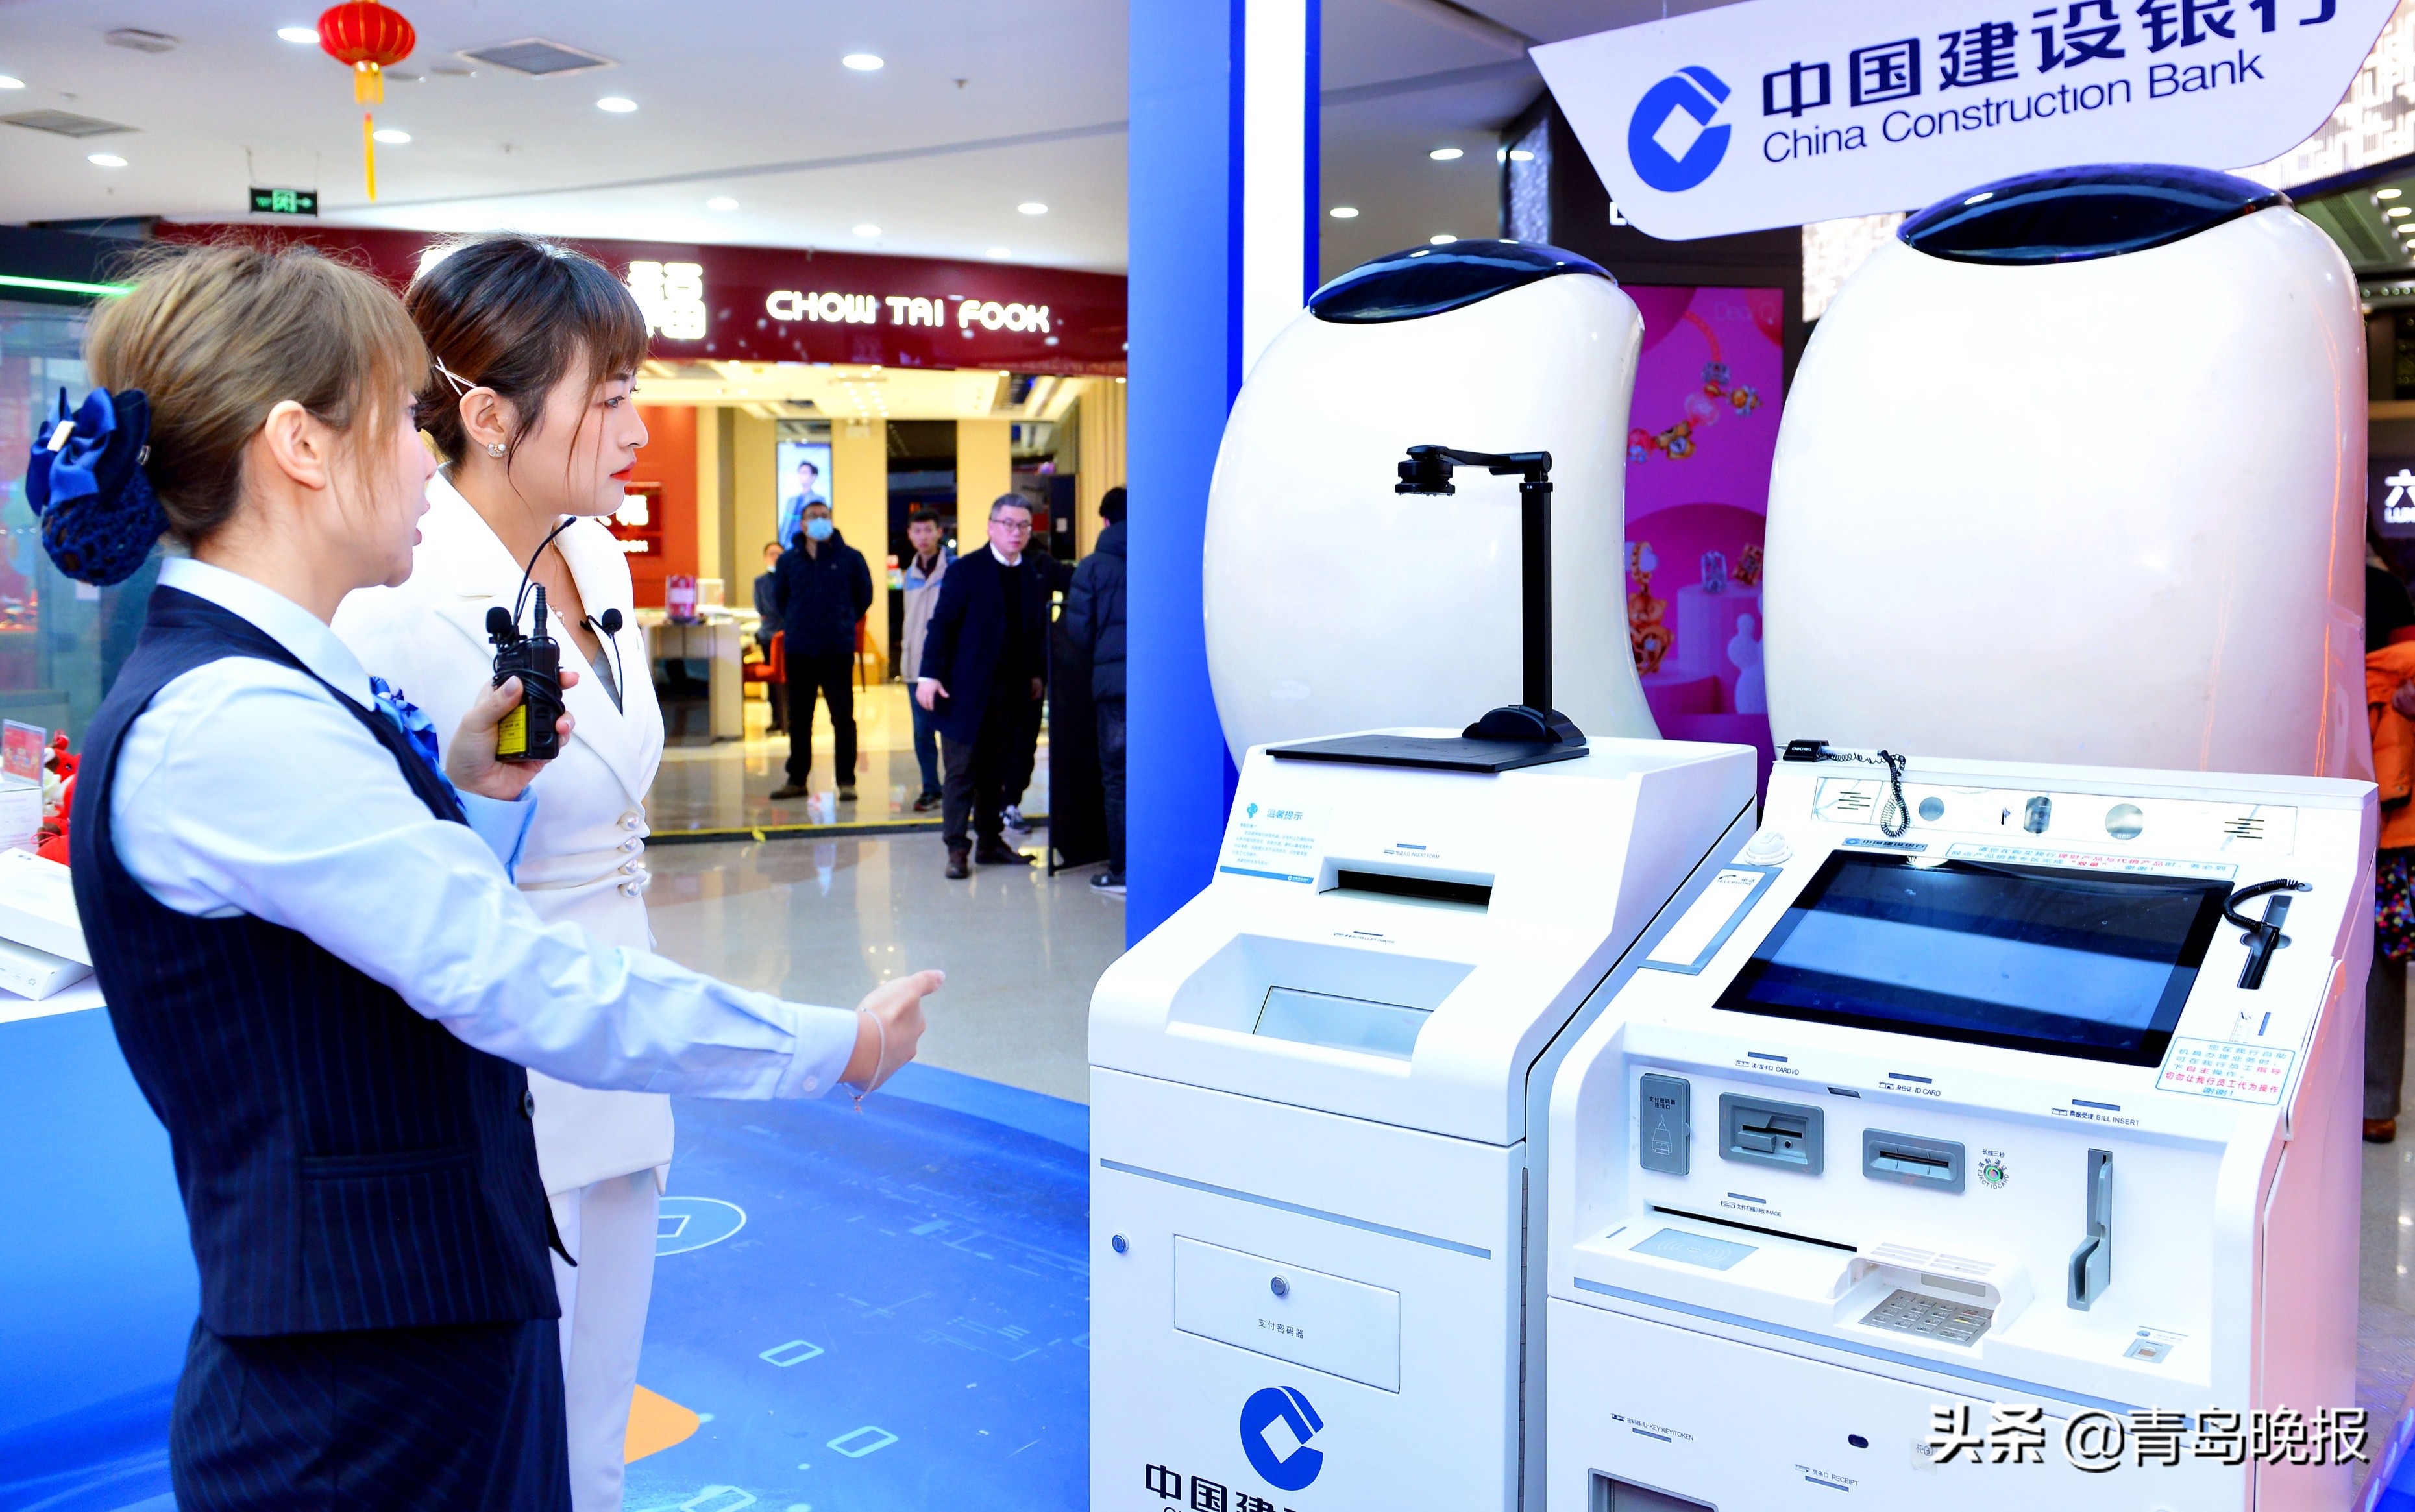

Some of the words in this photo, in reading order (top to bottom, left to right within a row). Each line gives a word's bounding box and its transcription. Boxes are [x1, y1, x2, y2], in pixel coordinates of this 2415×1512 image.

[1763, 125, 1867, 162] China
[1883, 78, 2131, 142] Construction
[2149, 49, 2265, 99] Bank
[766, 289, 876, 324] CHOW
[885, 295, 944, 328] TAI
[959, 299, 1051, 333] FOOK
[1266, 808, 1303, 821] 温馨提示
[2164, 1071, 2280, 1093] 切勿让我行员工代为操作
[1922, 1088, 1941, 1097] CARD
[2112, 1117, 2140, 1127] INSERT
[1258, 1318, 1304, 1339] 支付密码器
[1831, 1474, 1859, 1487] RECEIPT
